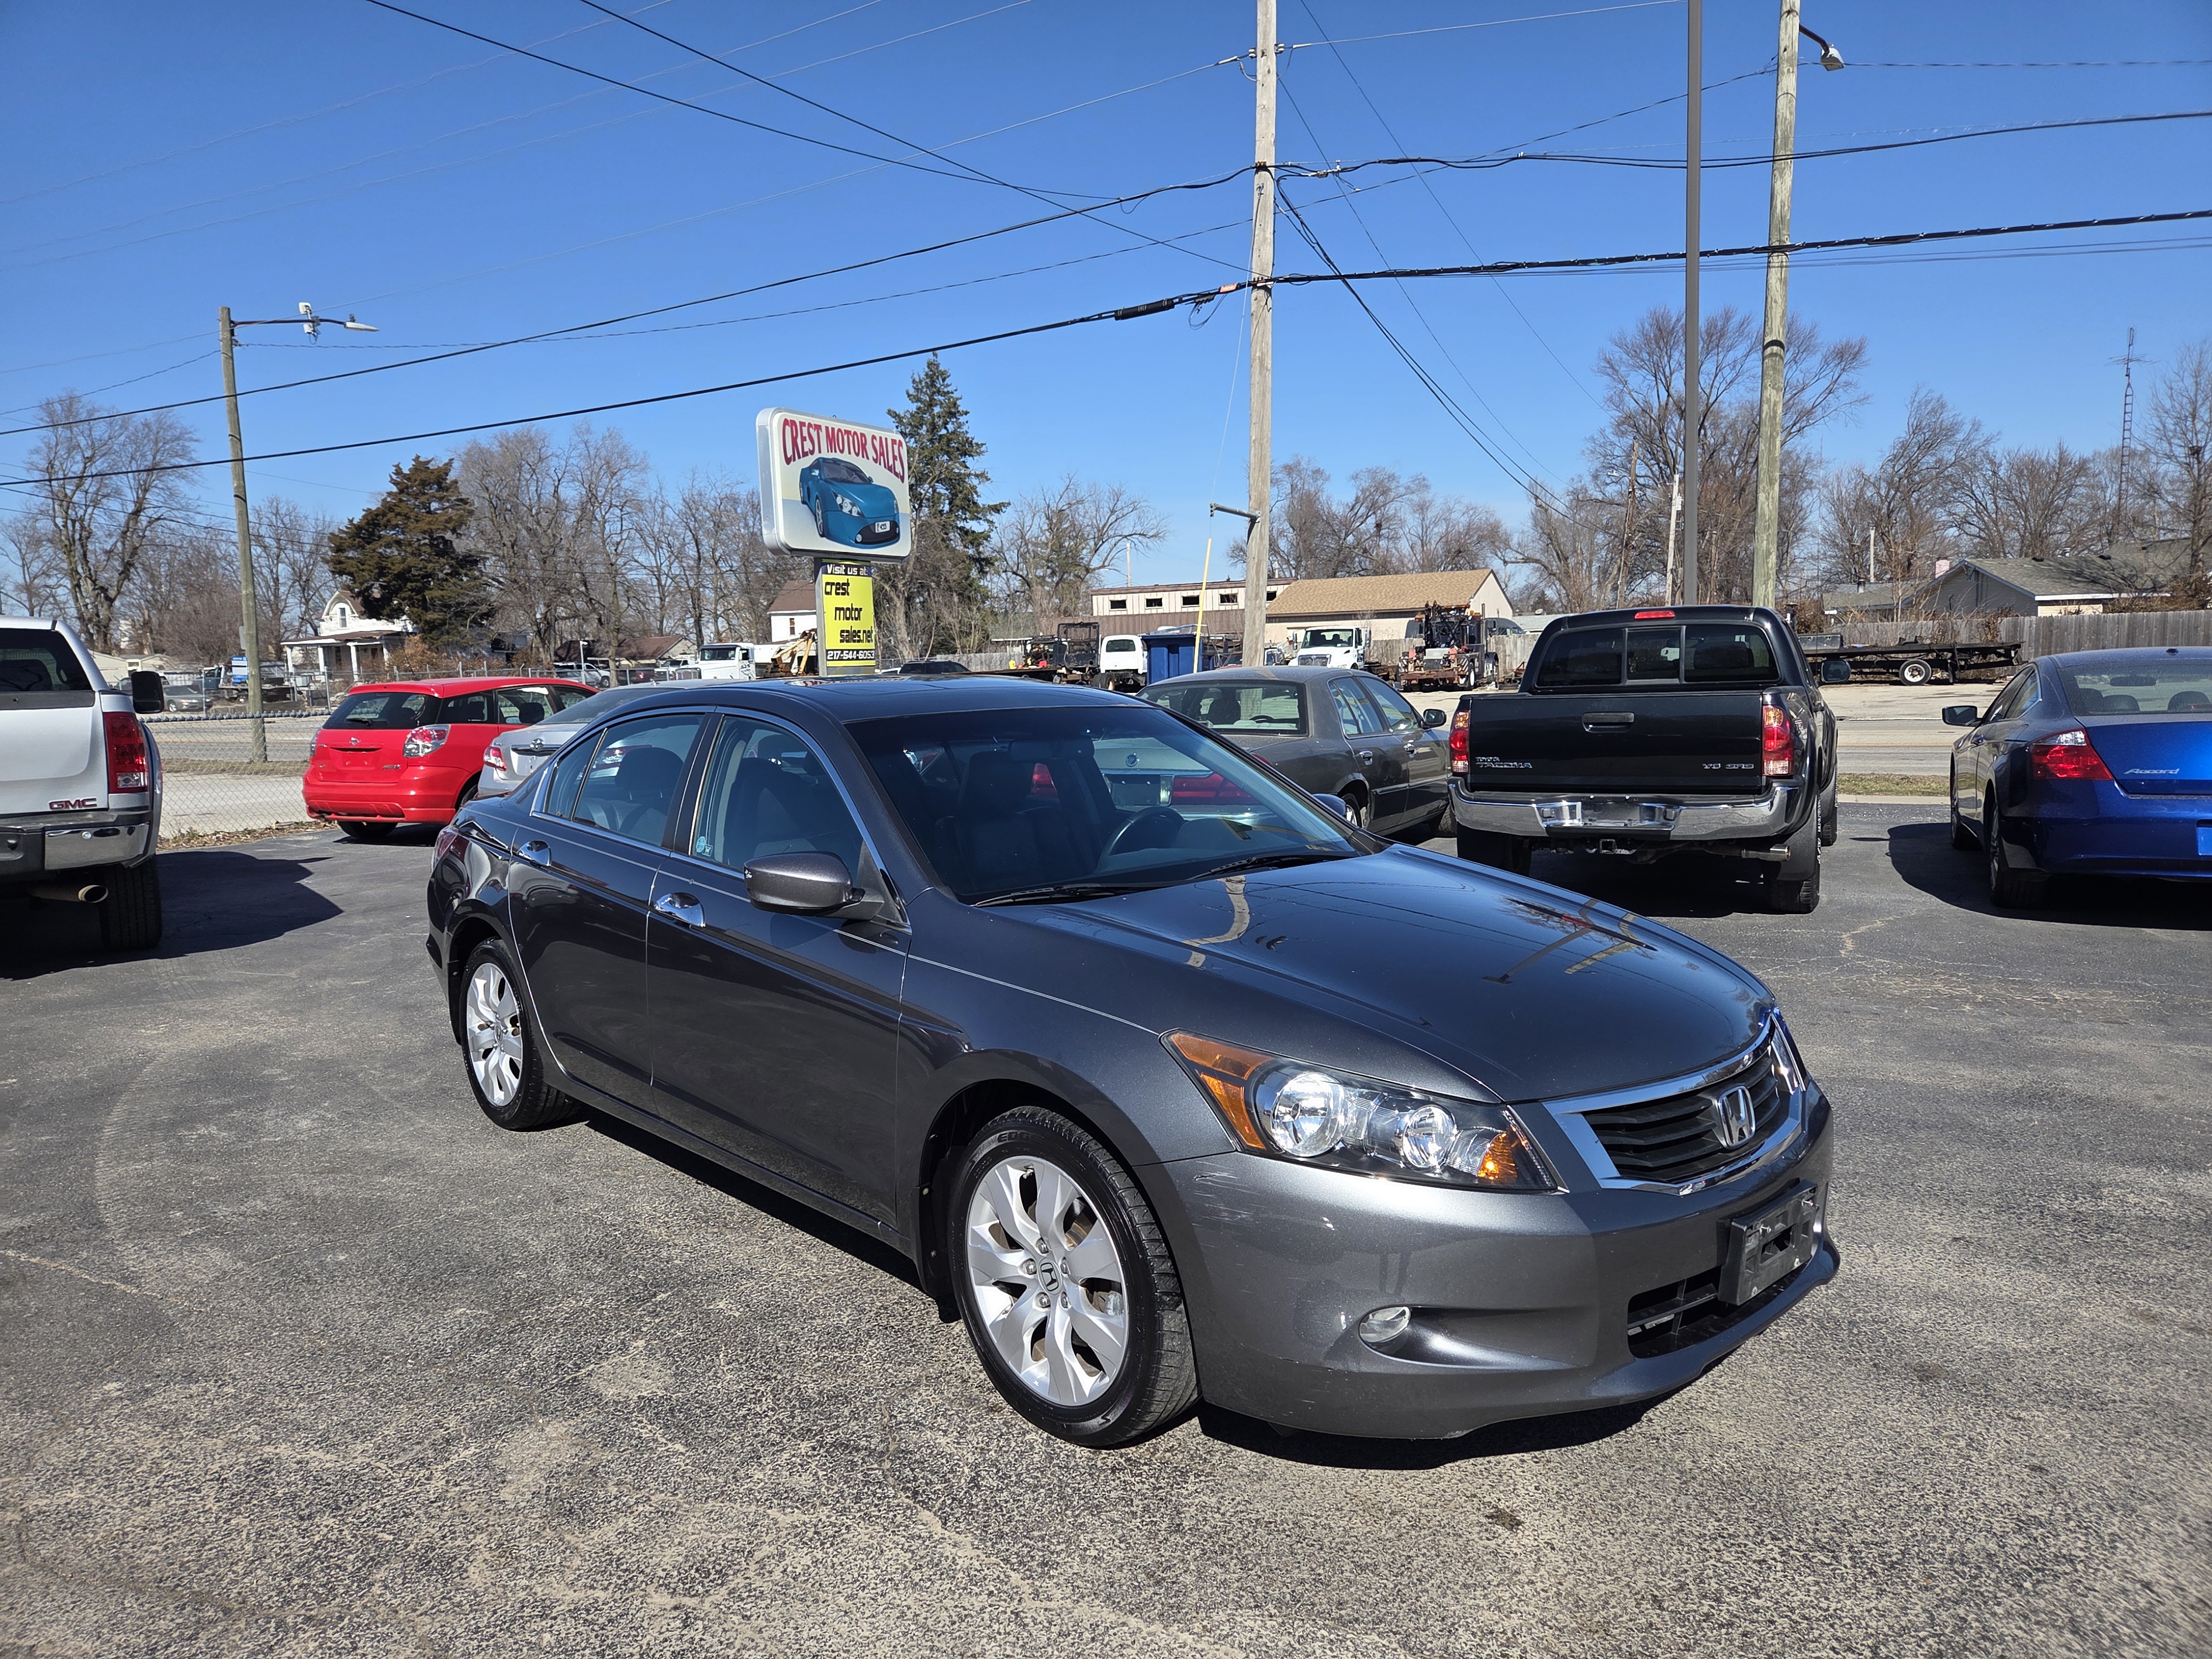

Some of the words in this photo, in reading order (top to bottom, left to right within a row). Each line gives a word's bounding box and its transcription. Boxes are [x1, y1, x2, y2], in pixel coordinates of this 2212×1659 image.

[782, 418, 822, 465] CREST
[825, 426, 869, 460] MOTOR
[871, 434, 905, 484] SALES
[827, 564, 846, 575] Visit
[825, 578, 850, 596] crest
[834, 603, 863, 621] motor
[839, 625, 873, 644] sales.net
[827, 650, 875, 660] 217-544-6053
[48, 797, 97, 811] GMC
